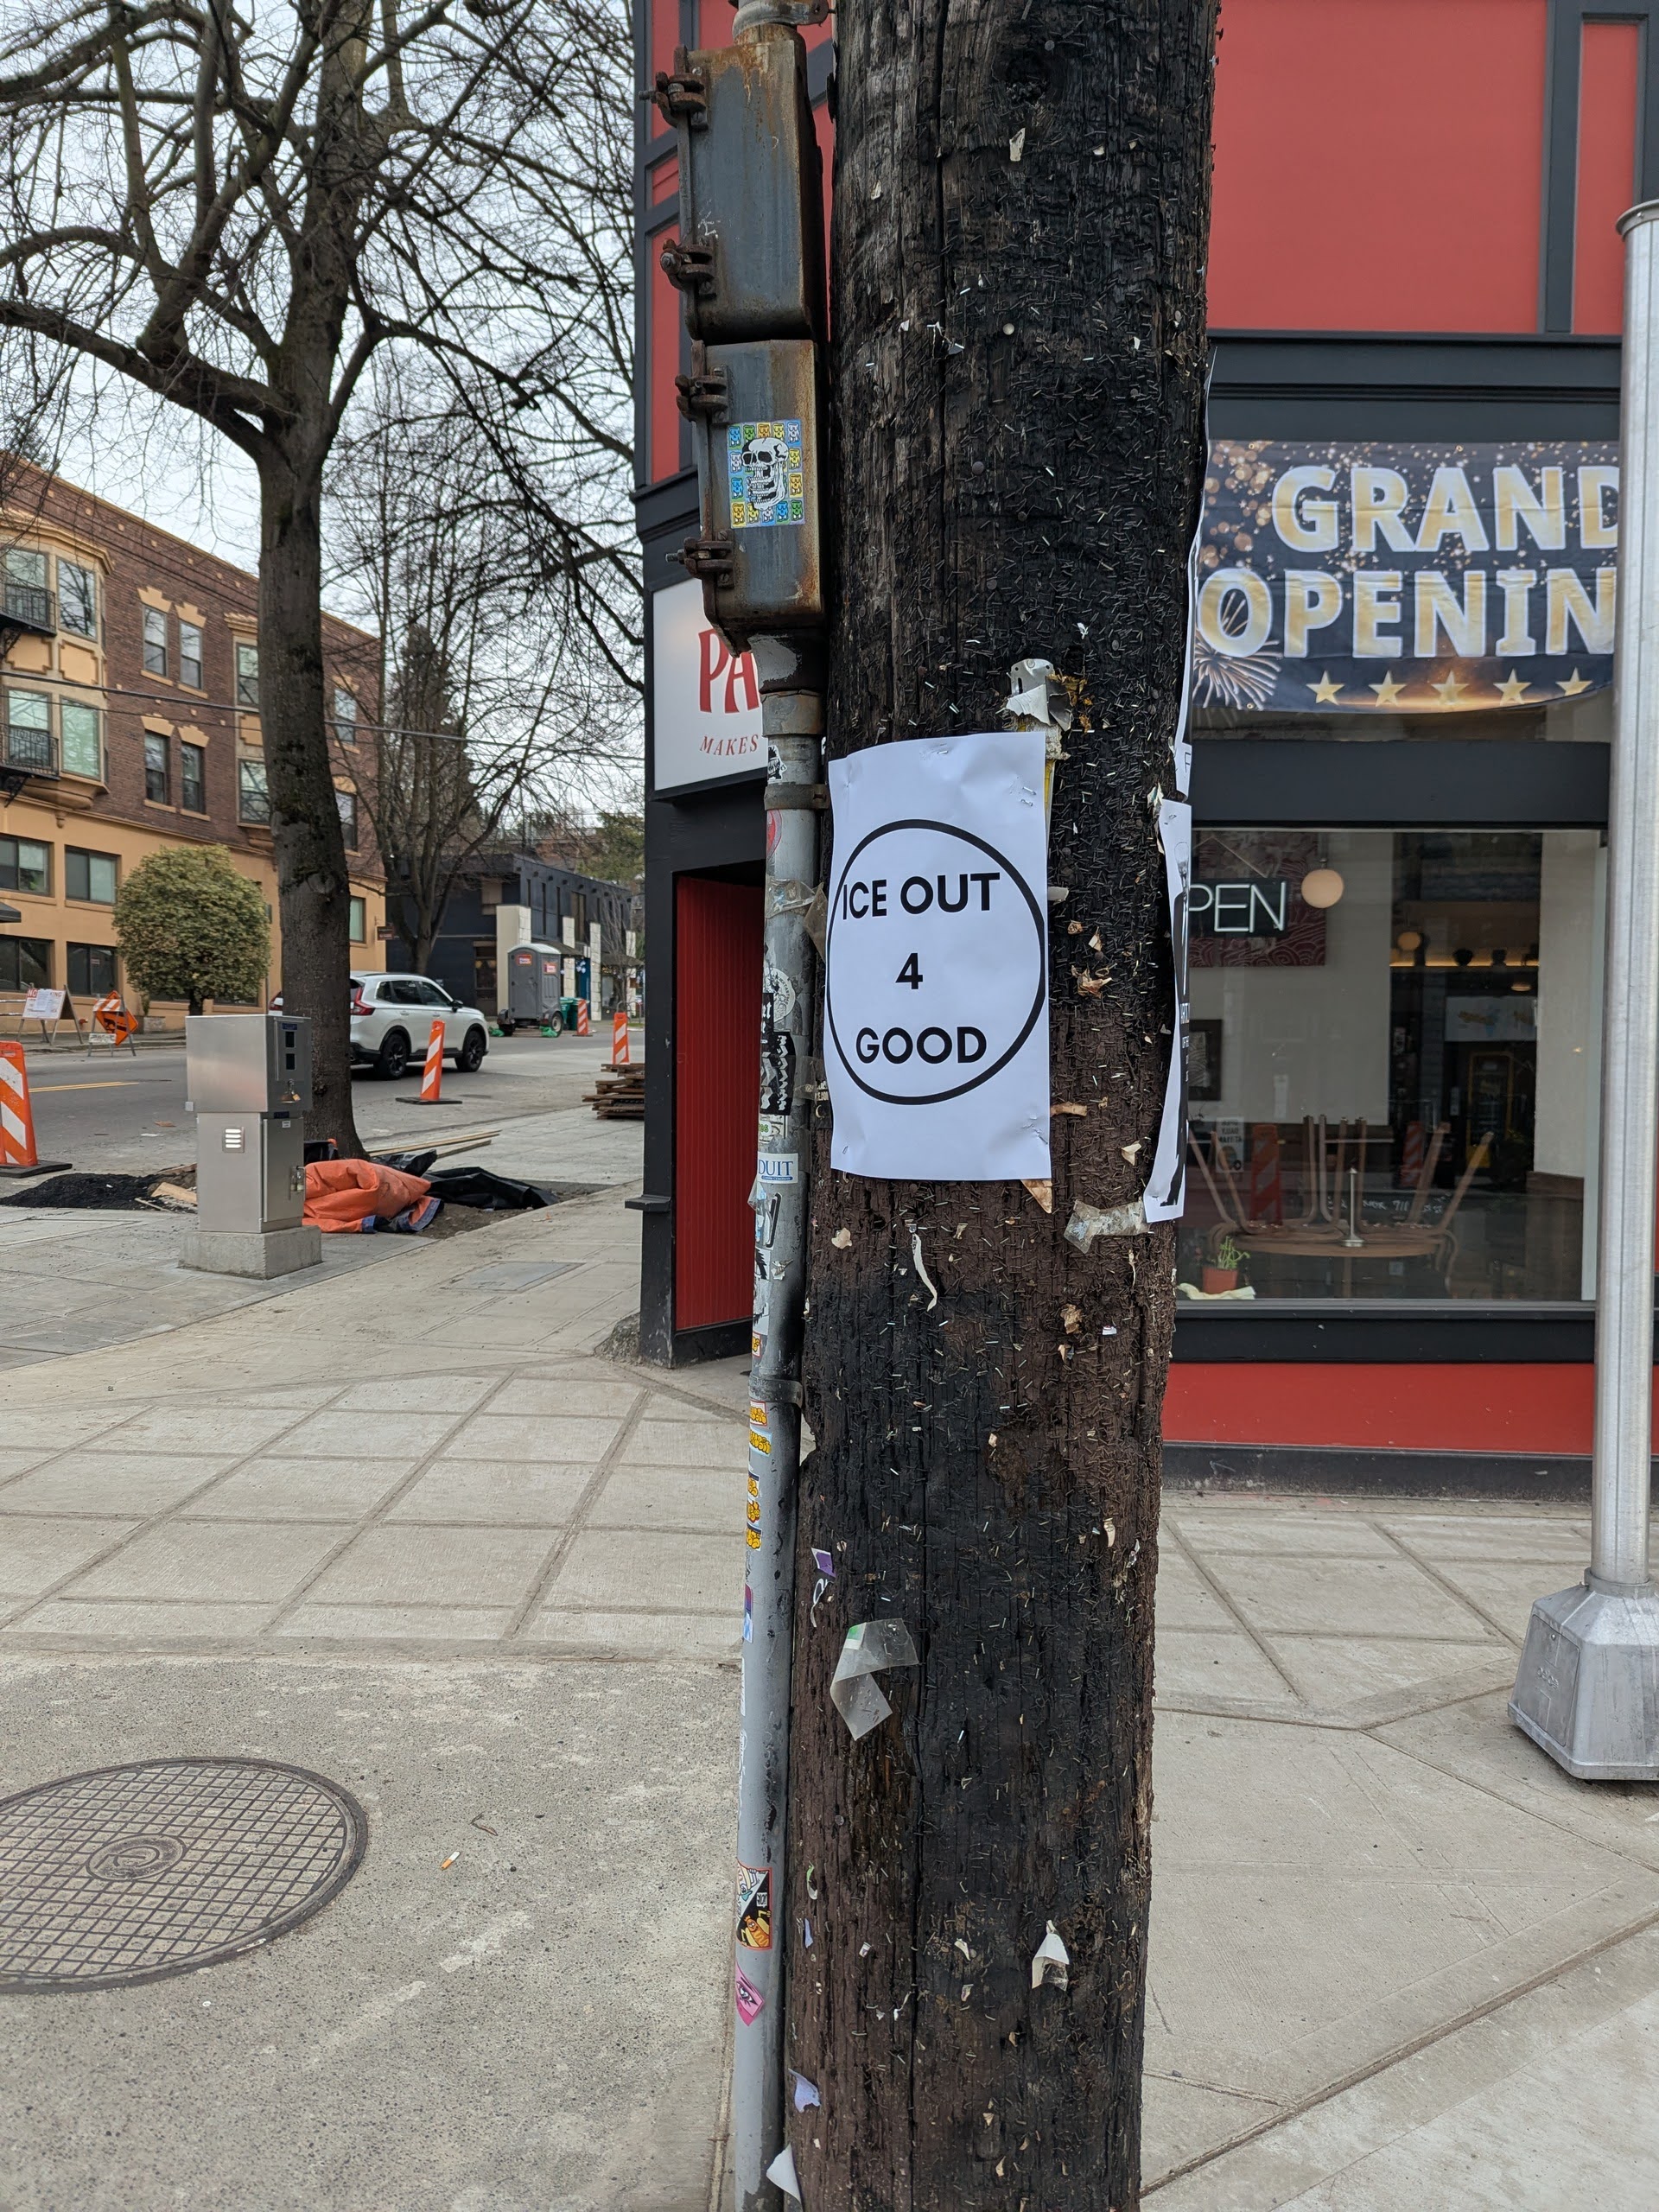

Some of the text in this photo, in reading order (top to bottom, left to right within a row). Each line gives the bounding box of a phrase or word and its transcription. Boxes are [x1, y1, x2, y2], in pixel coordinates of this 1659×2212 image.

[1271, 466, 1619, 552] GRAND
[700, 734, 759, 756] MAKES
[842, 872, 1001, 920] ICE OUT
[895, 952, 924, 989] 4
[856, 1026, 987, 1065] GOOD
